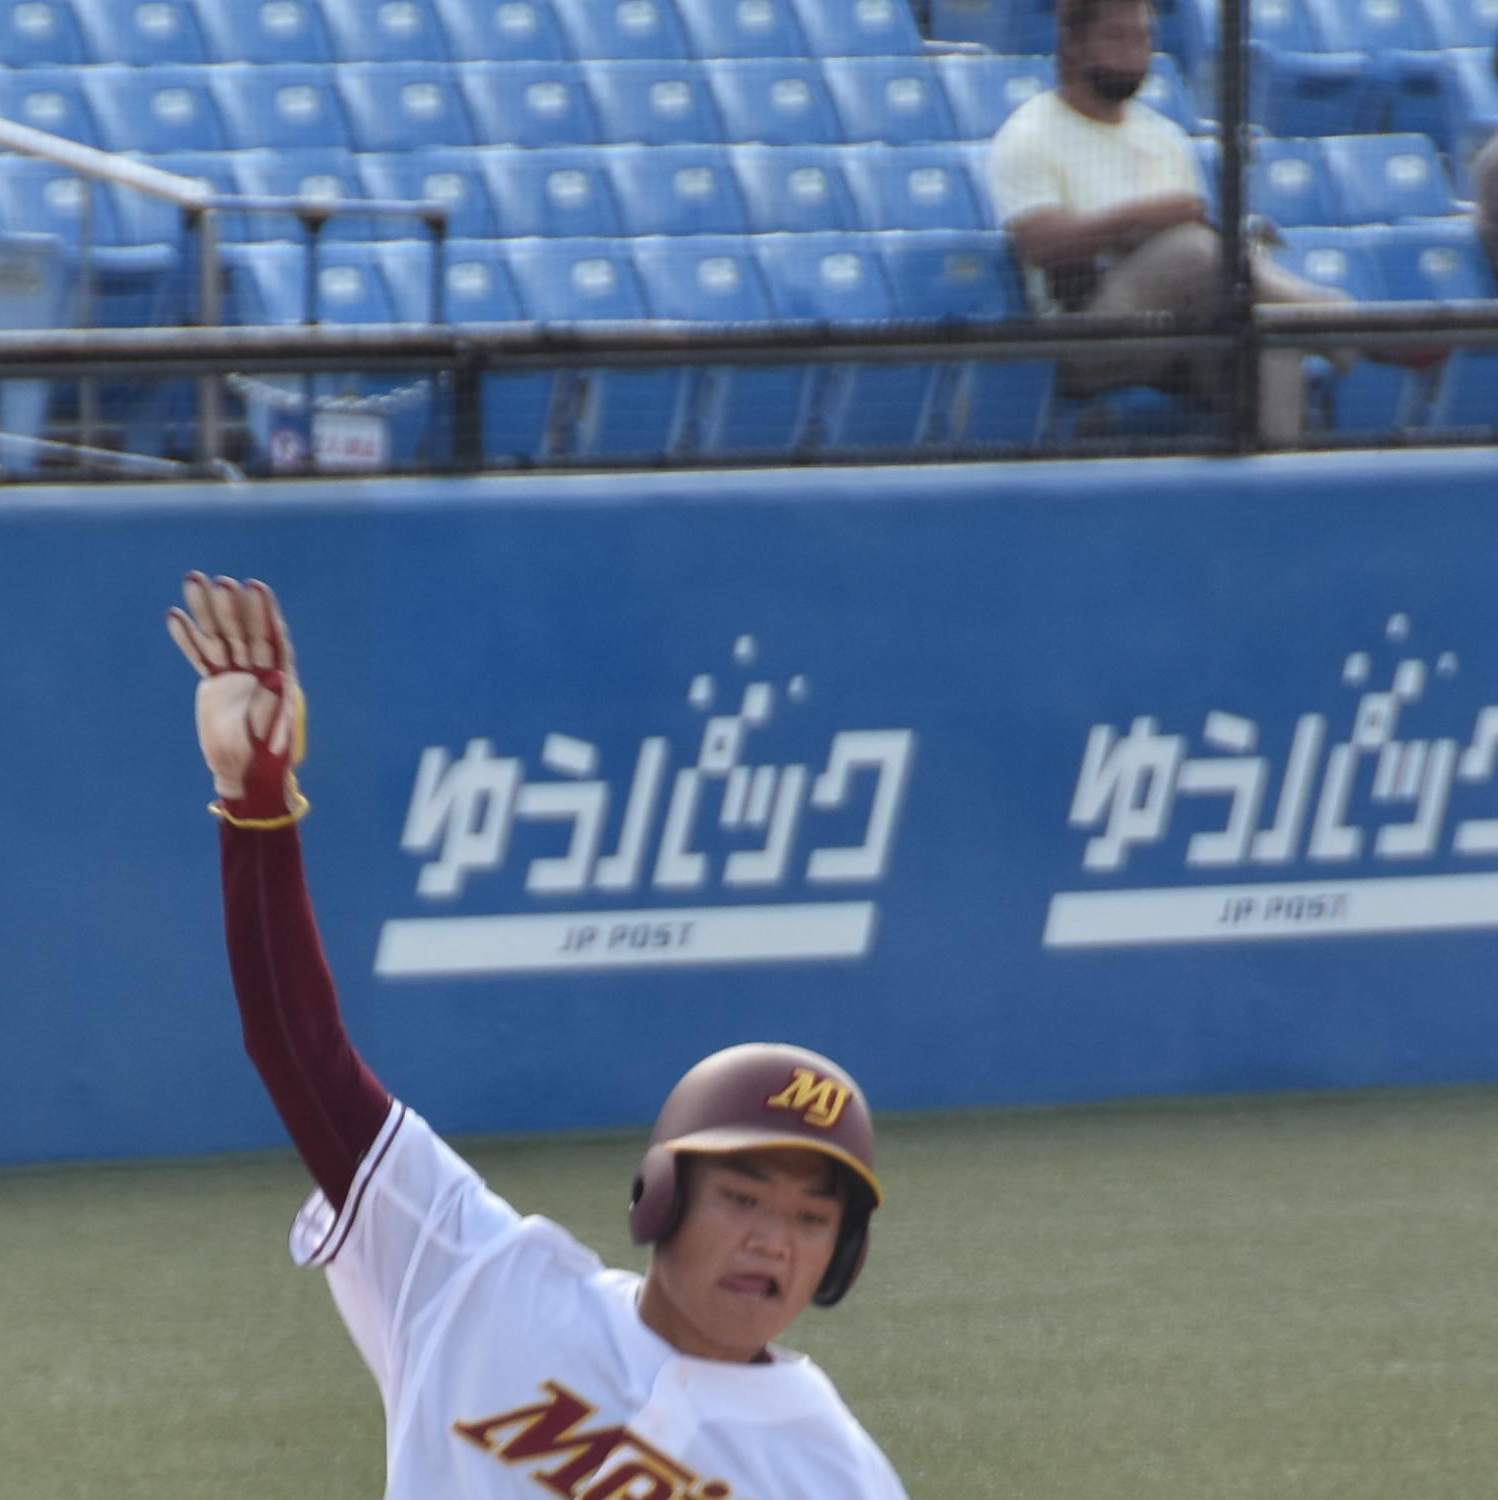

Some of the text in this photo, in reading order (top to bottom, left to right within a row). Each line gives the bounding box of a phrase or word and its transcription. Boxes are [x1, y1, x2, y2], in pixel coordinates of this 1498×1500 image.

[1261, 892, 1350, 922] POST
[556, 919, 697, 952] JP POST
[765, 1065, 853, 1129] MJ
